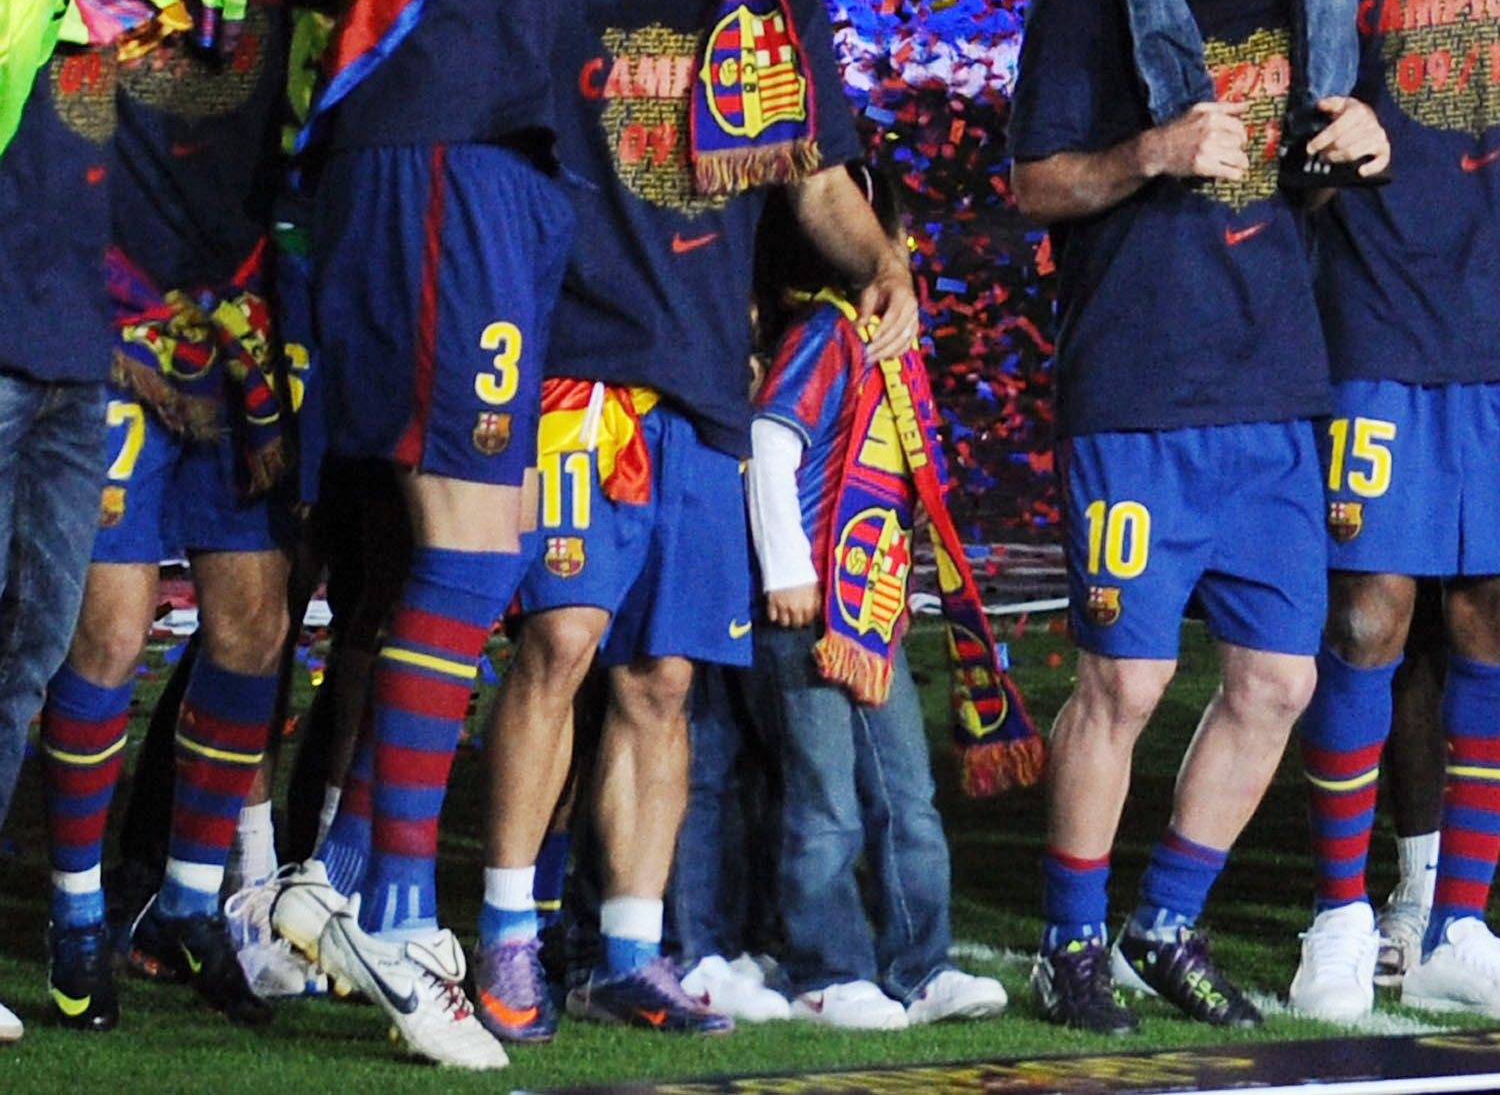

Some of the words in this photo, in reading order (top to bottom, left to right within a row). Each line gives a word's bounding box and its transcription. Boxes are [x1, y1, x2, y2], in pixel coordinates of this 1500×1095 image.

[474, 319, 523, 405] 3
[537, 452, 591, 529] 11
[1328, 416, 1397, 498] 15
[1084, 499, 1151, 580] 10
